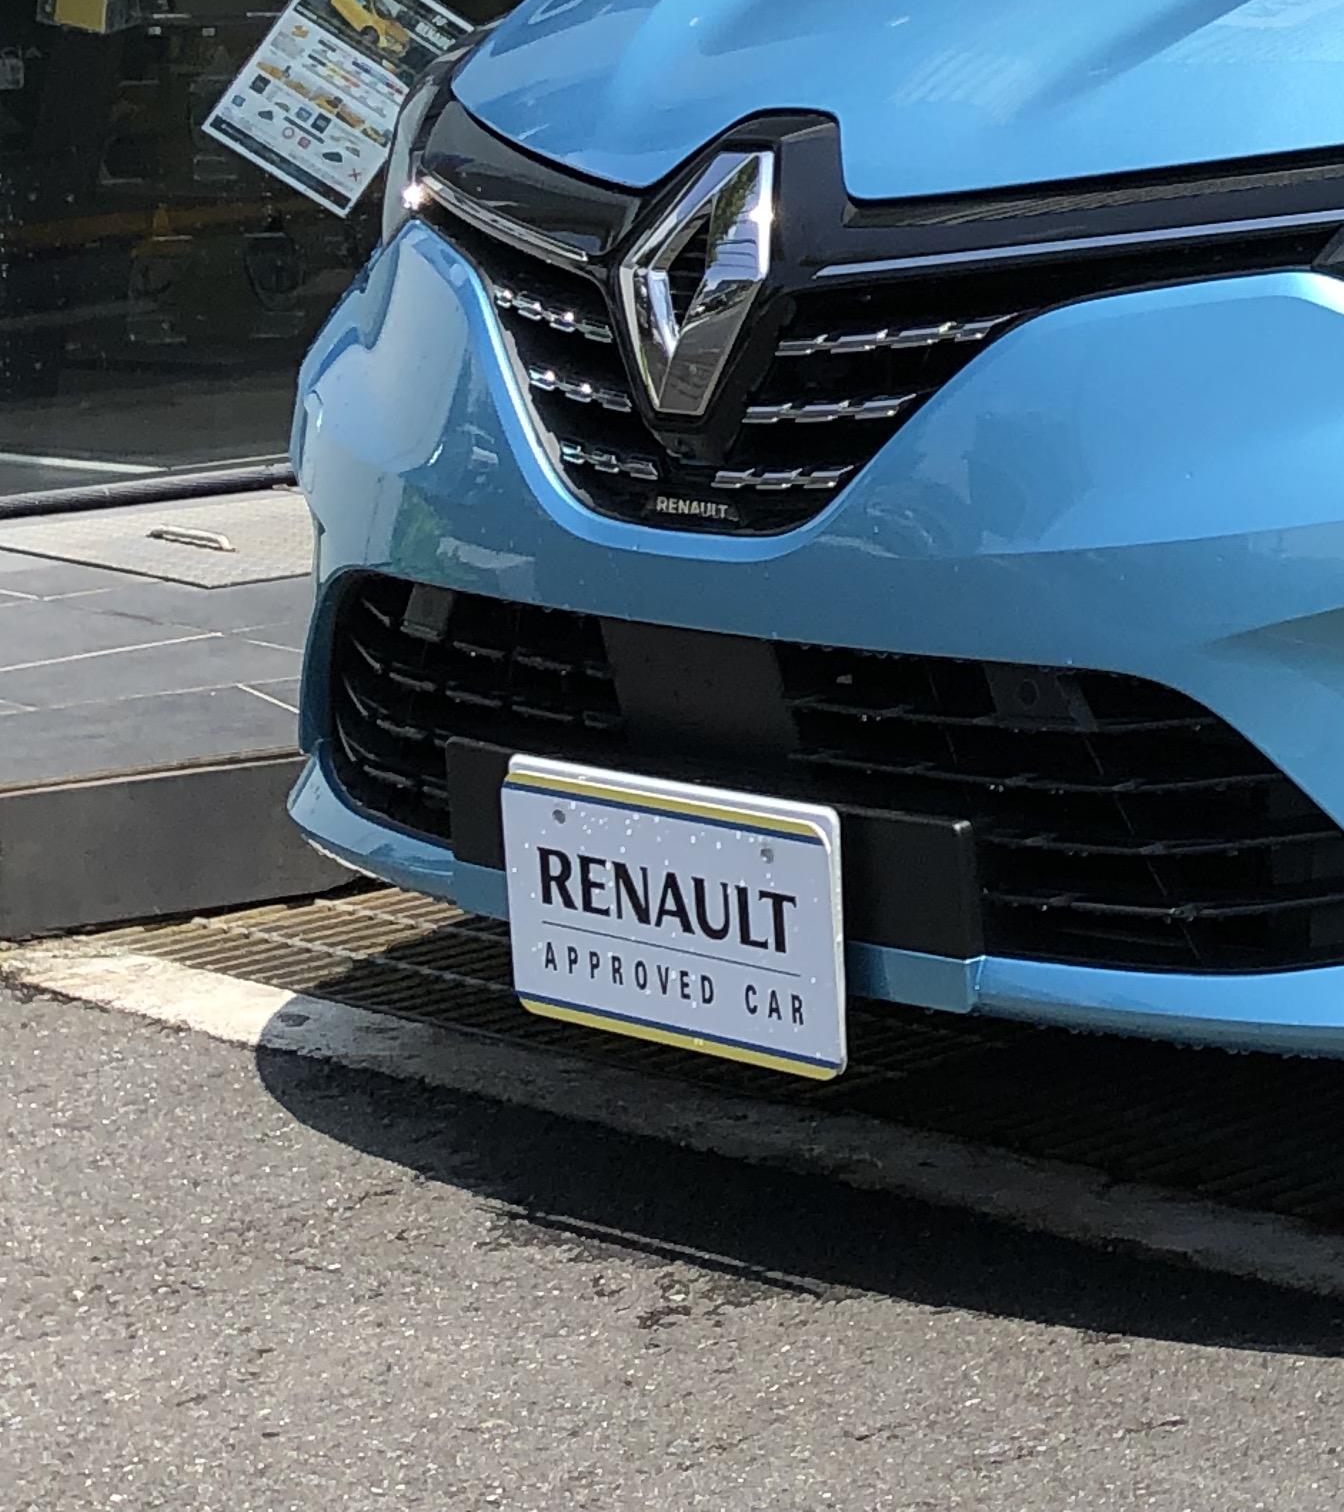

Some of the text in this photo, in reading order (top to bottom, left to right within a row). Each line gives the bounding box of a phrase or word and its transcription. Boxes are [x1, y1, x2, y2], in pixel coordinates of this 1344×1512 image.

[656, 496, 728, 519] RENAULT
[537, 846, 797, 953] RENAULT
[545, 941, 804, 1025] APPROVED CAR
